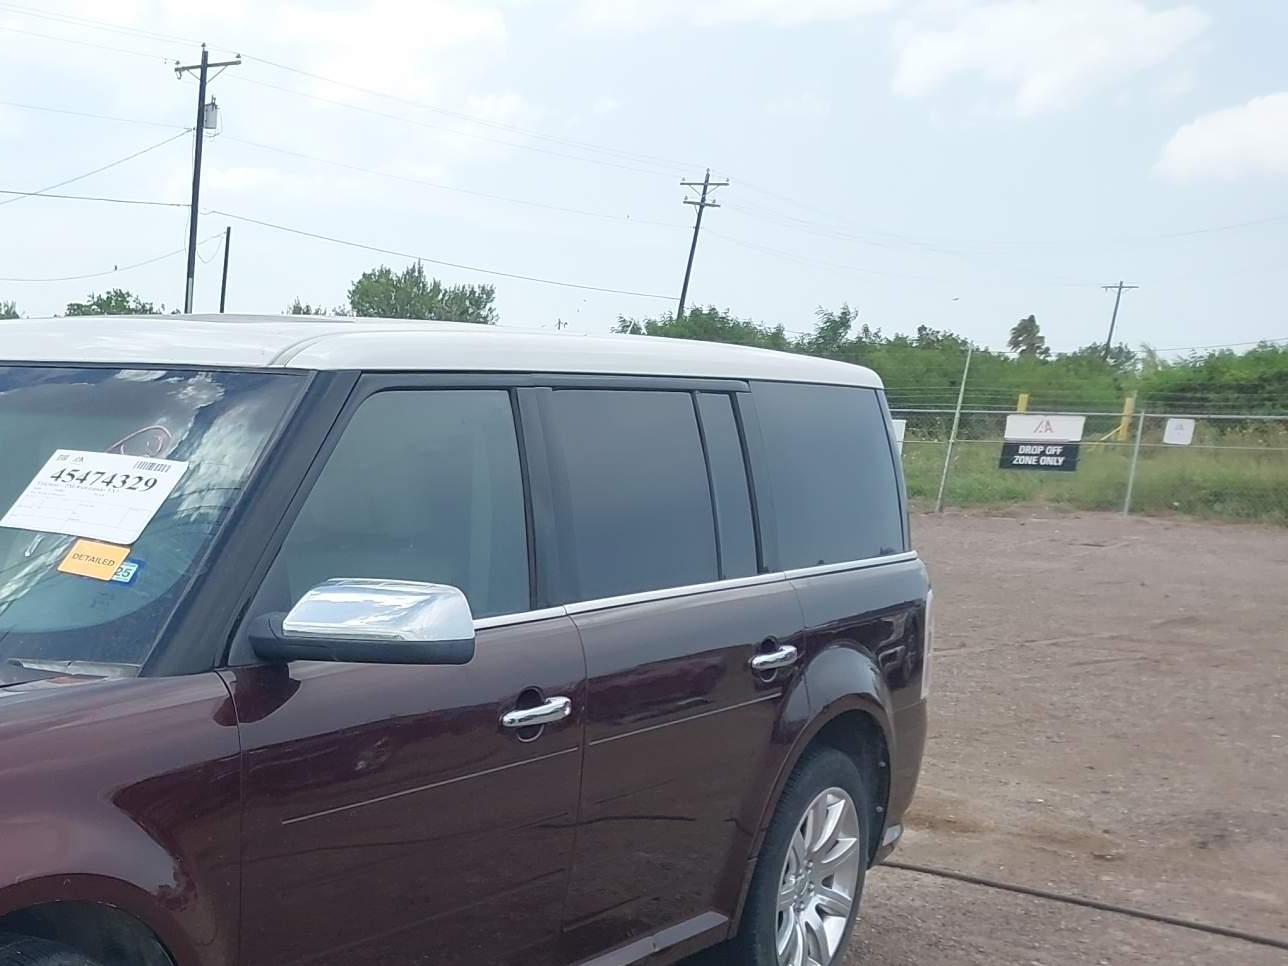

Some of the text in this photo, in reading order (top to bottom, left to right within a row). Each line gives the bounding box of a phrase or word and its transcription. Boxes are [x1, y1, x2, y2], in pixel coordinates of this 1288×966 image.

[1018, 445, 1064, 456] DROP OFF
[1012, 455, 1065, 466] ZONE ONLY
[50, 467, 158, 492] 45474329
[72, 552, 116, 567] DETAILED
[115, 566, 133, 578] 25
